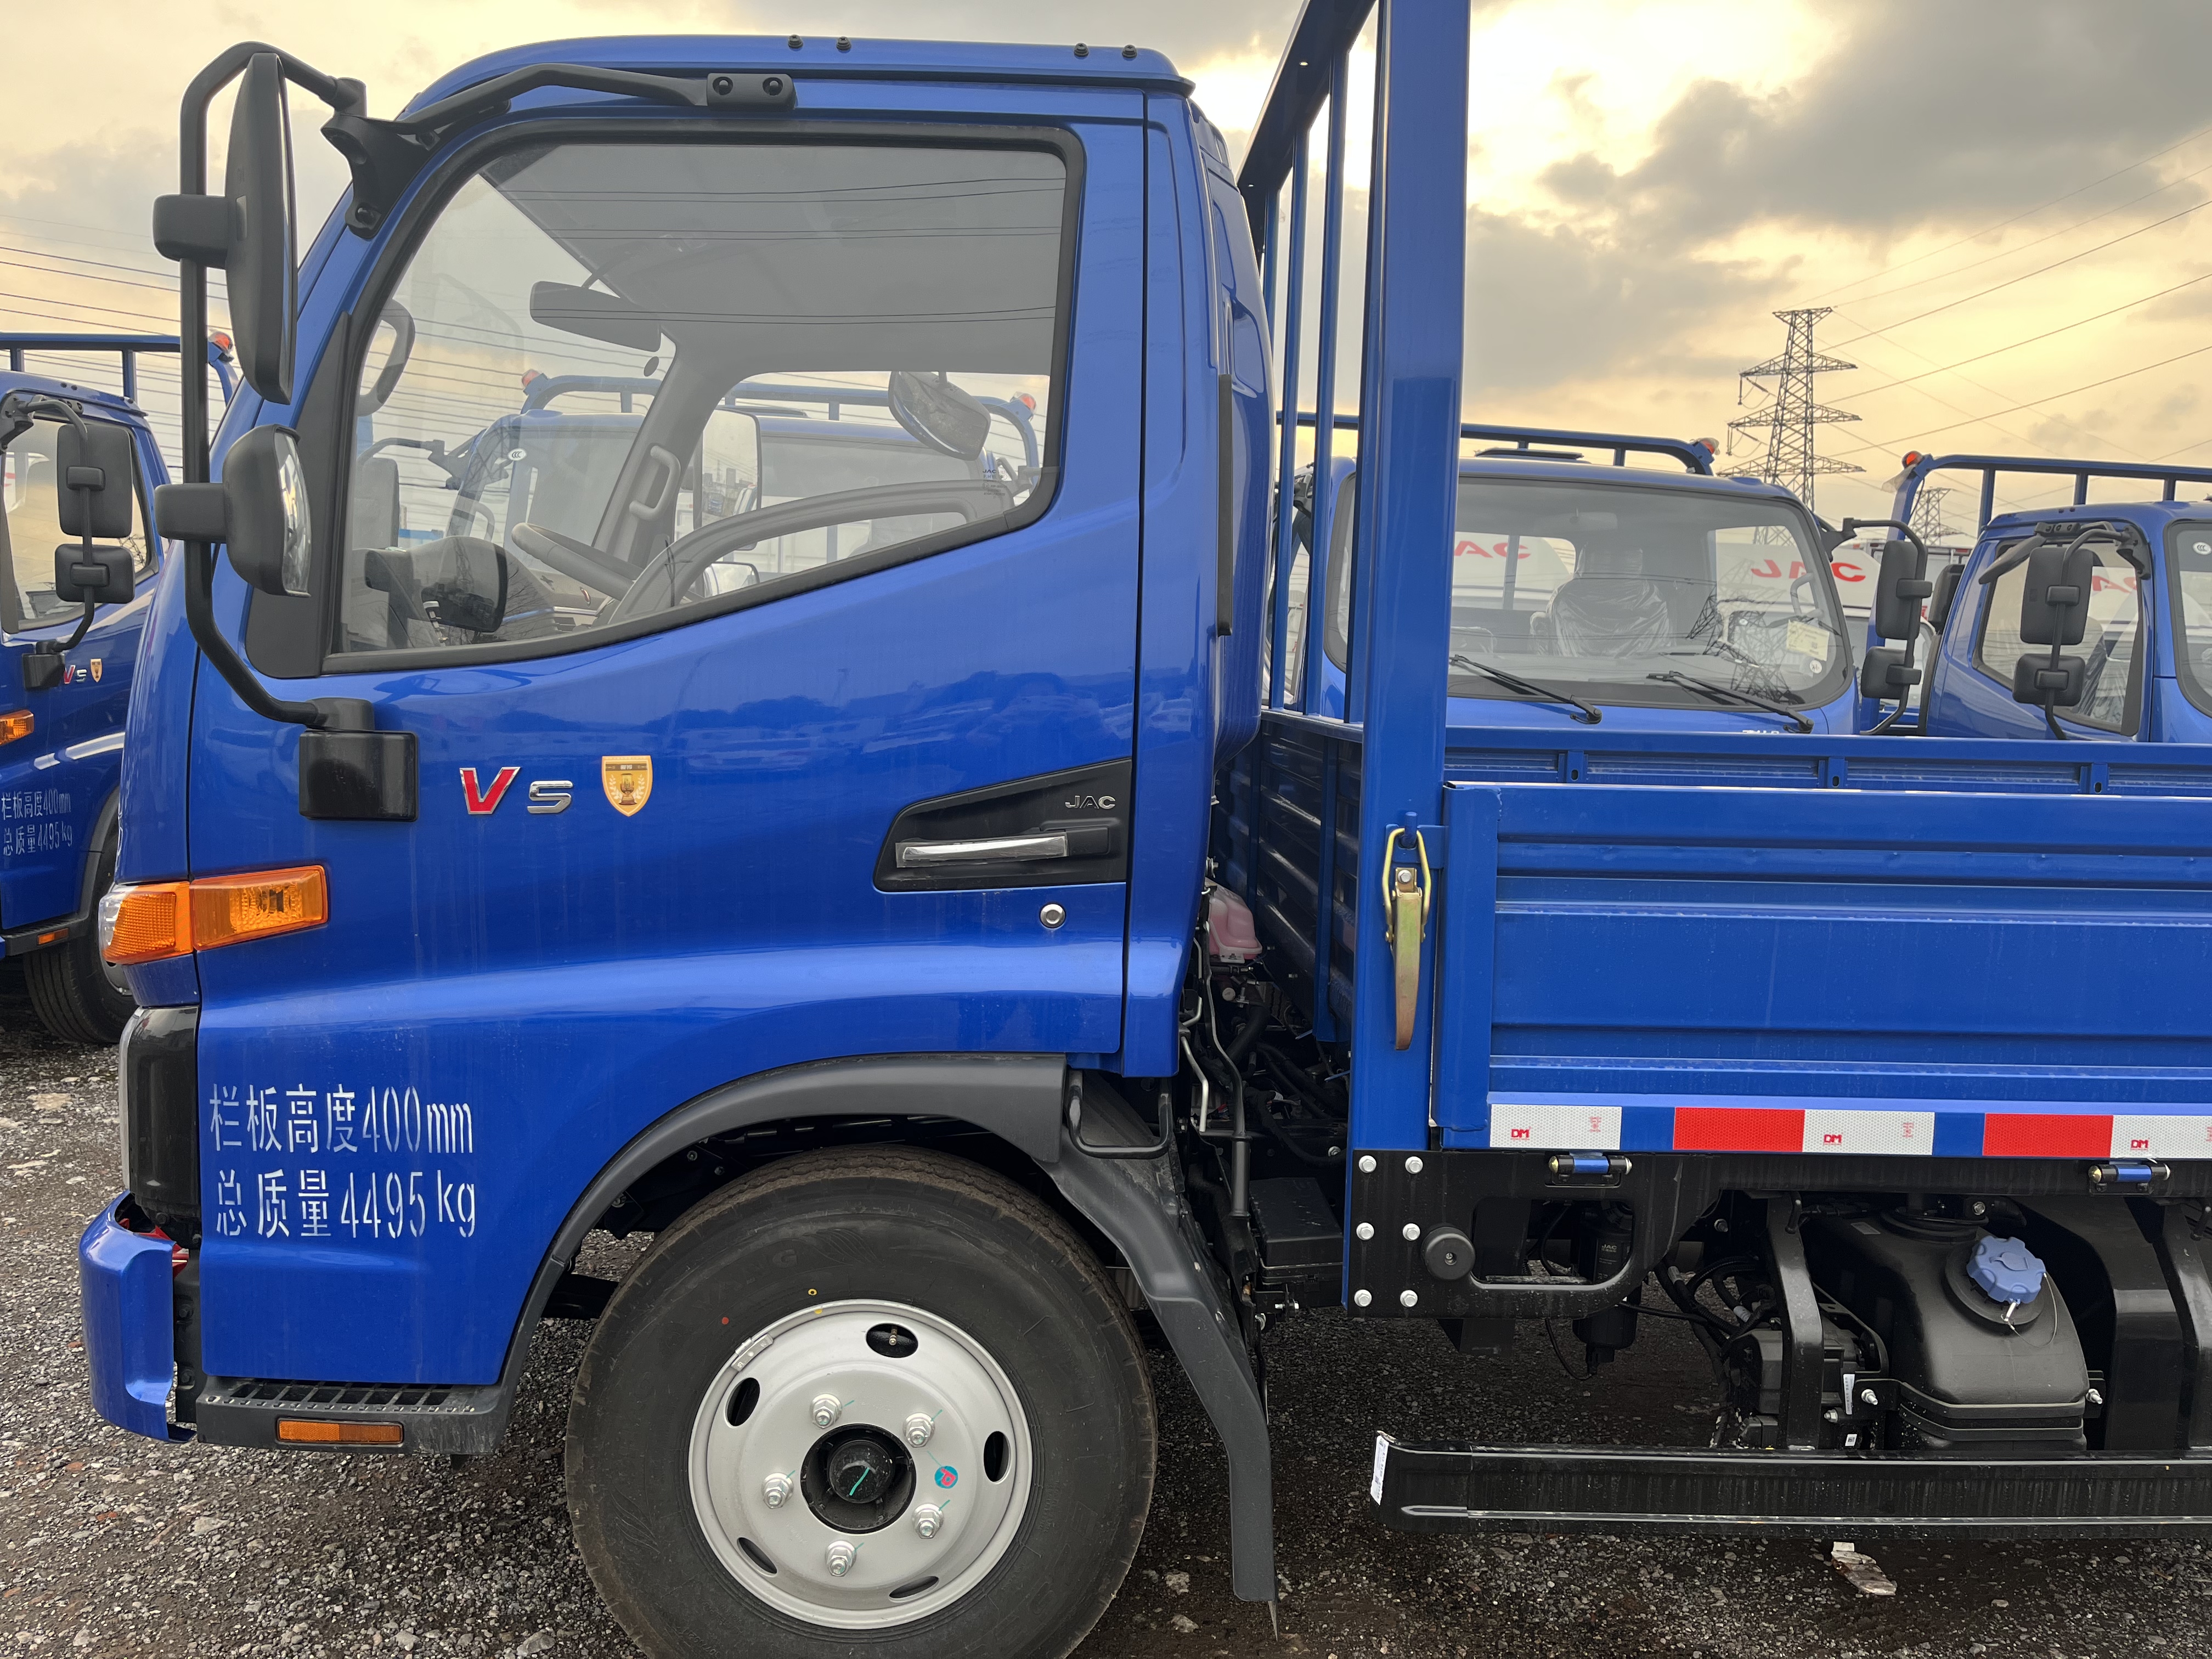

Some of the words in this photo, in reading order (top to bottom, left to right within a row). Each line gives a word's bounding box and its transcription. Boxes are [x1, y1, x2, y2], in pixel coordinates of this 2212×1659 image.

[1454, 540, 1531, 559] AC
[1, 788, 72, 820] 栏板高度400mm
[1065, 795, 1116, 810] JAC
[209, 1083, 473, 1154] 栏板高度400mm
[1510, 1128, 1530, 1138] DM
[1823, 1134, 1842, 1143] DM
[2131, 1139, 2149, 1148] DM
[216, 1169, 476, 1239] 总质量4495kg
